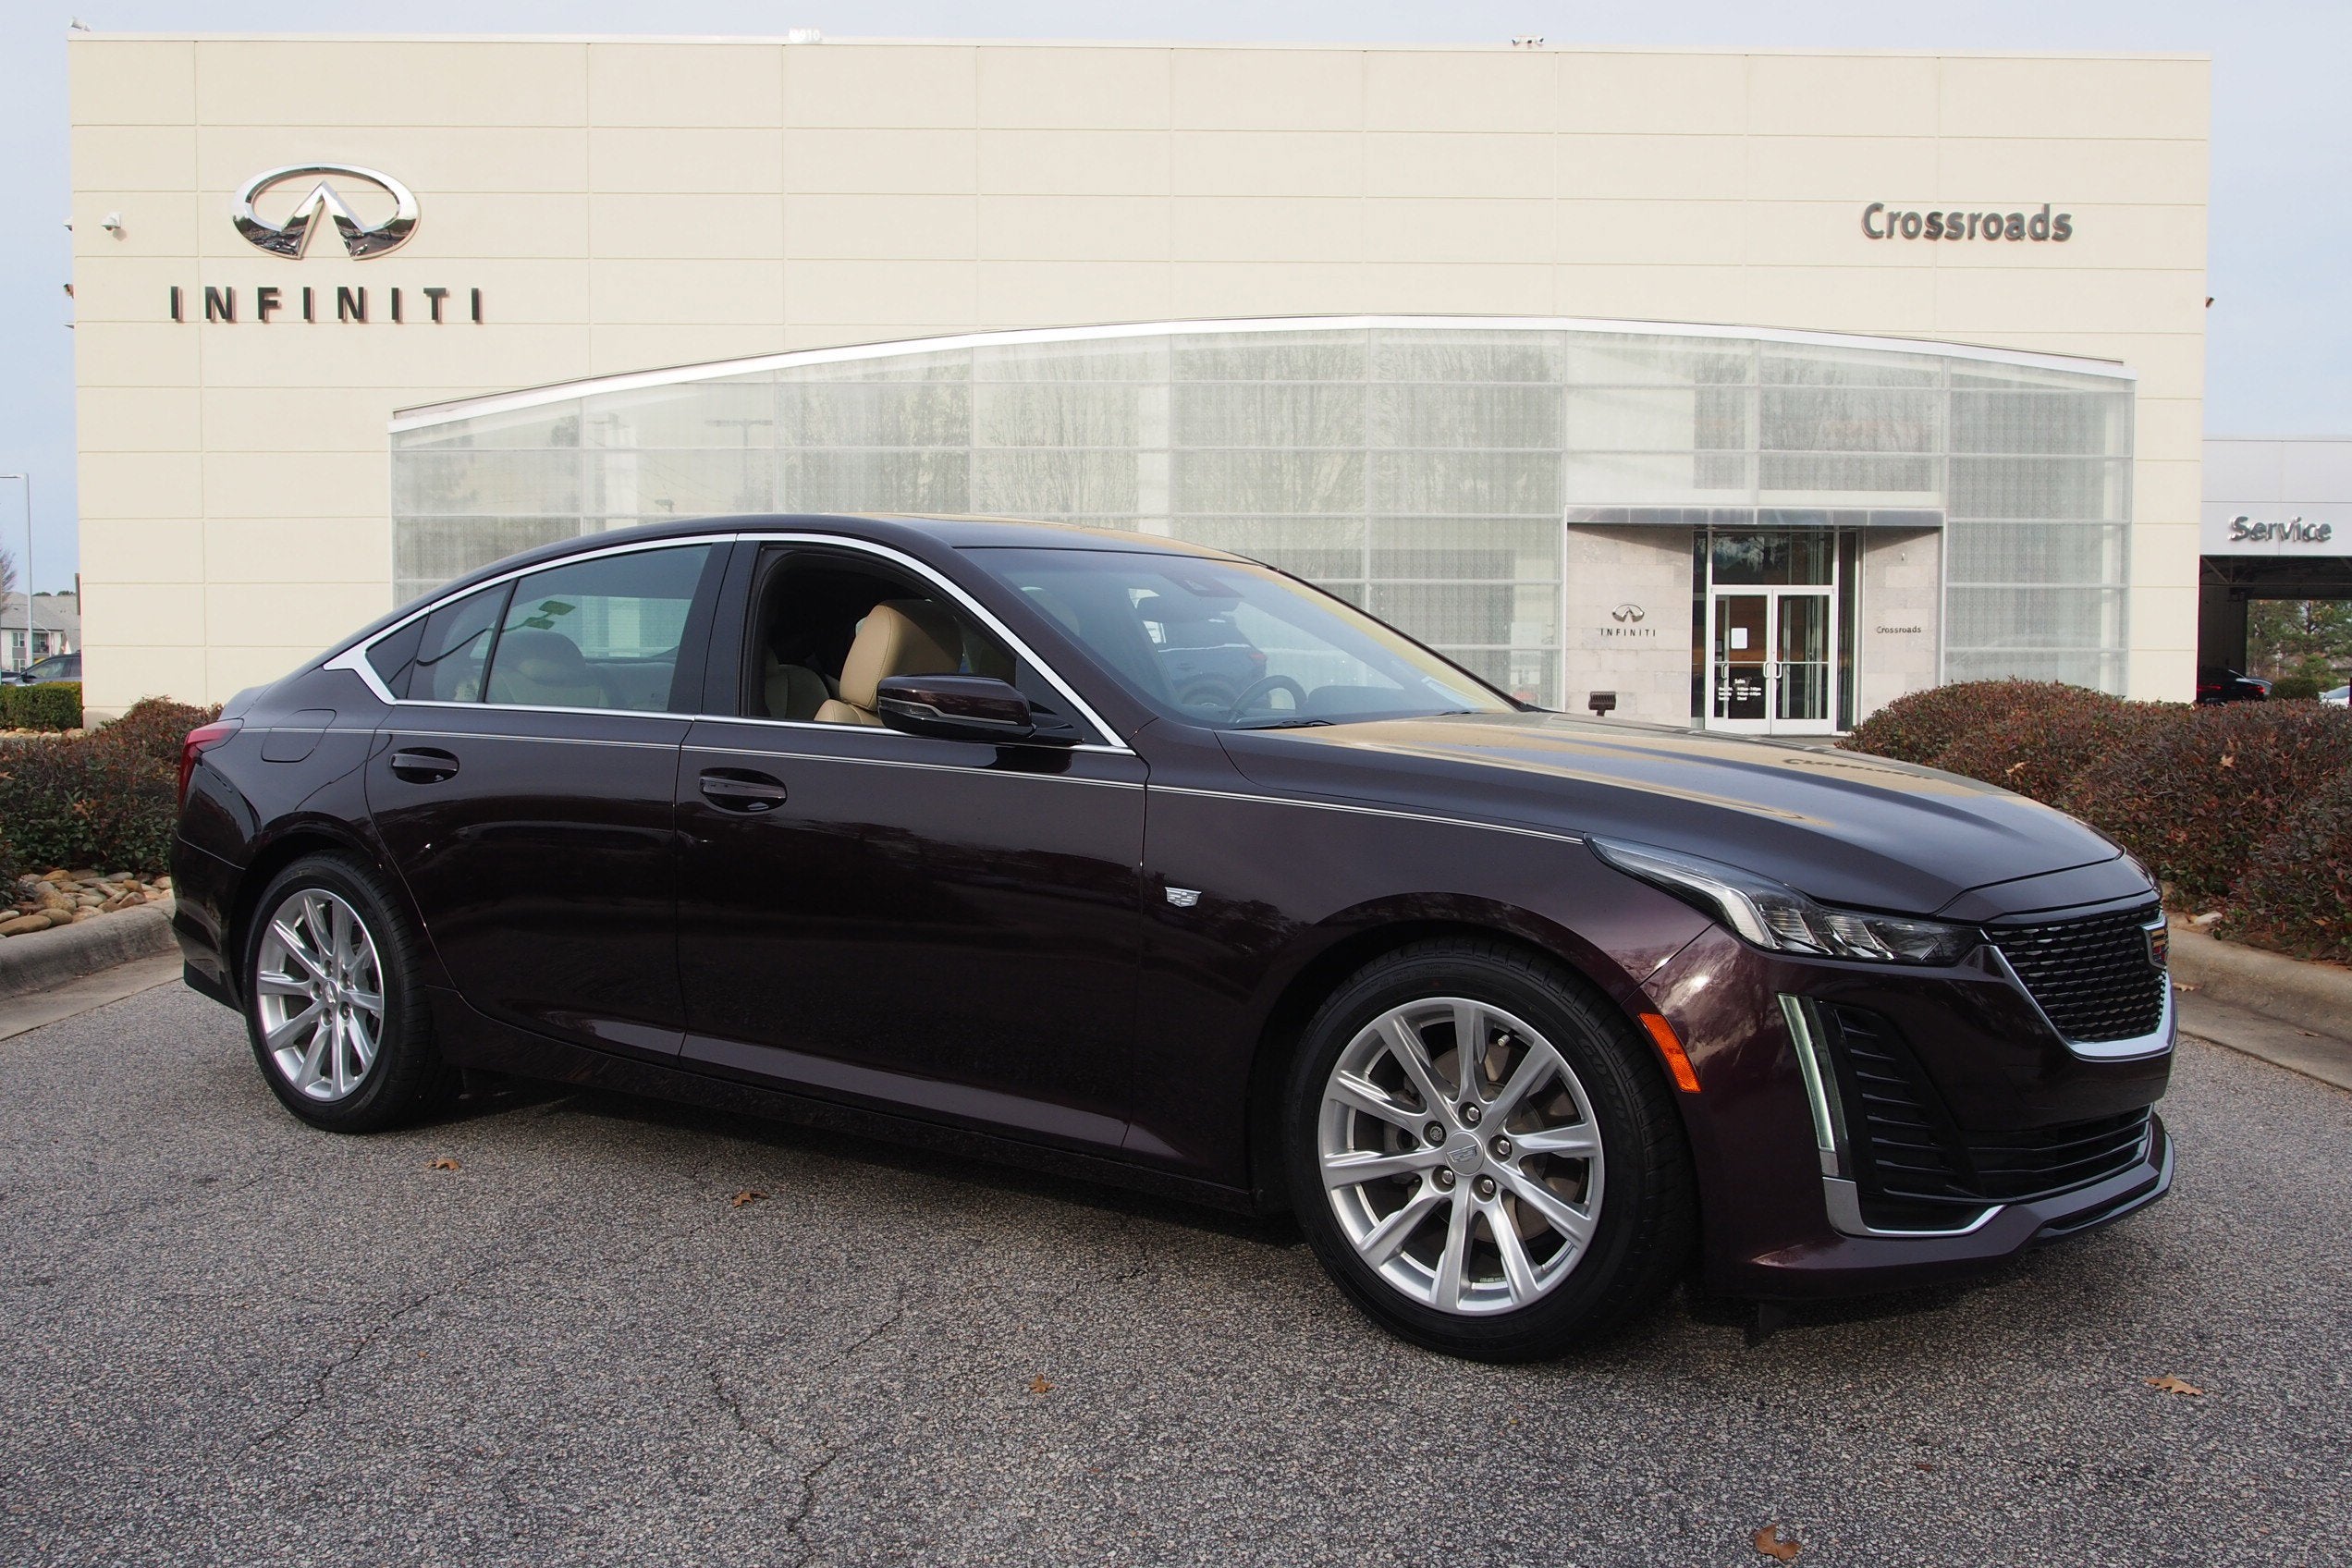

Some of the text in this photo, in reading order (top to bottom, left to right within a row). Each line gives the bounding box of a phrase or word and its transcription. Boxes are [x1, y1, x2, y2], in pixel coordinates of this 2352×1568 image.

[1861, 202, 2073, 241] Crossroads
[170, 285, 484, 324] INFINITI
[2229, 516, 2332, 542] Service
[1600, 628, 1656, 637] INFINITI
[1876, 625, 1922, 634] Crossroads
